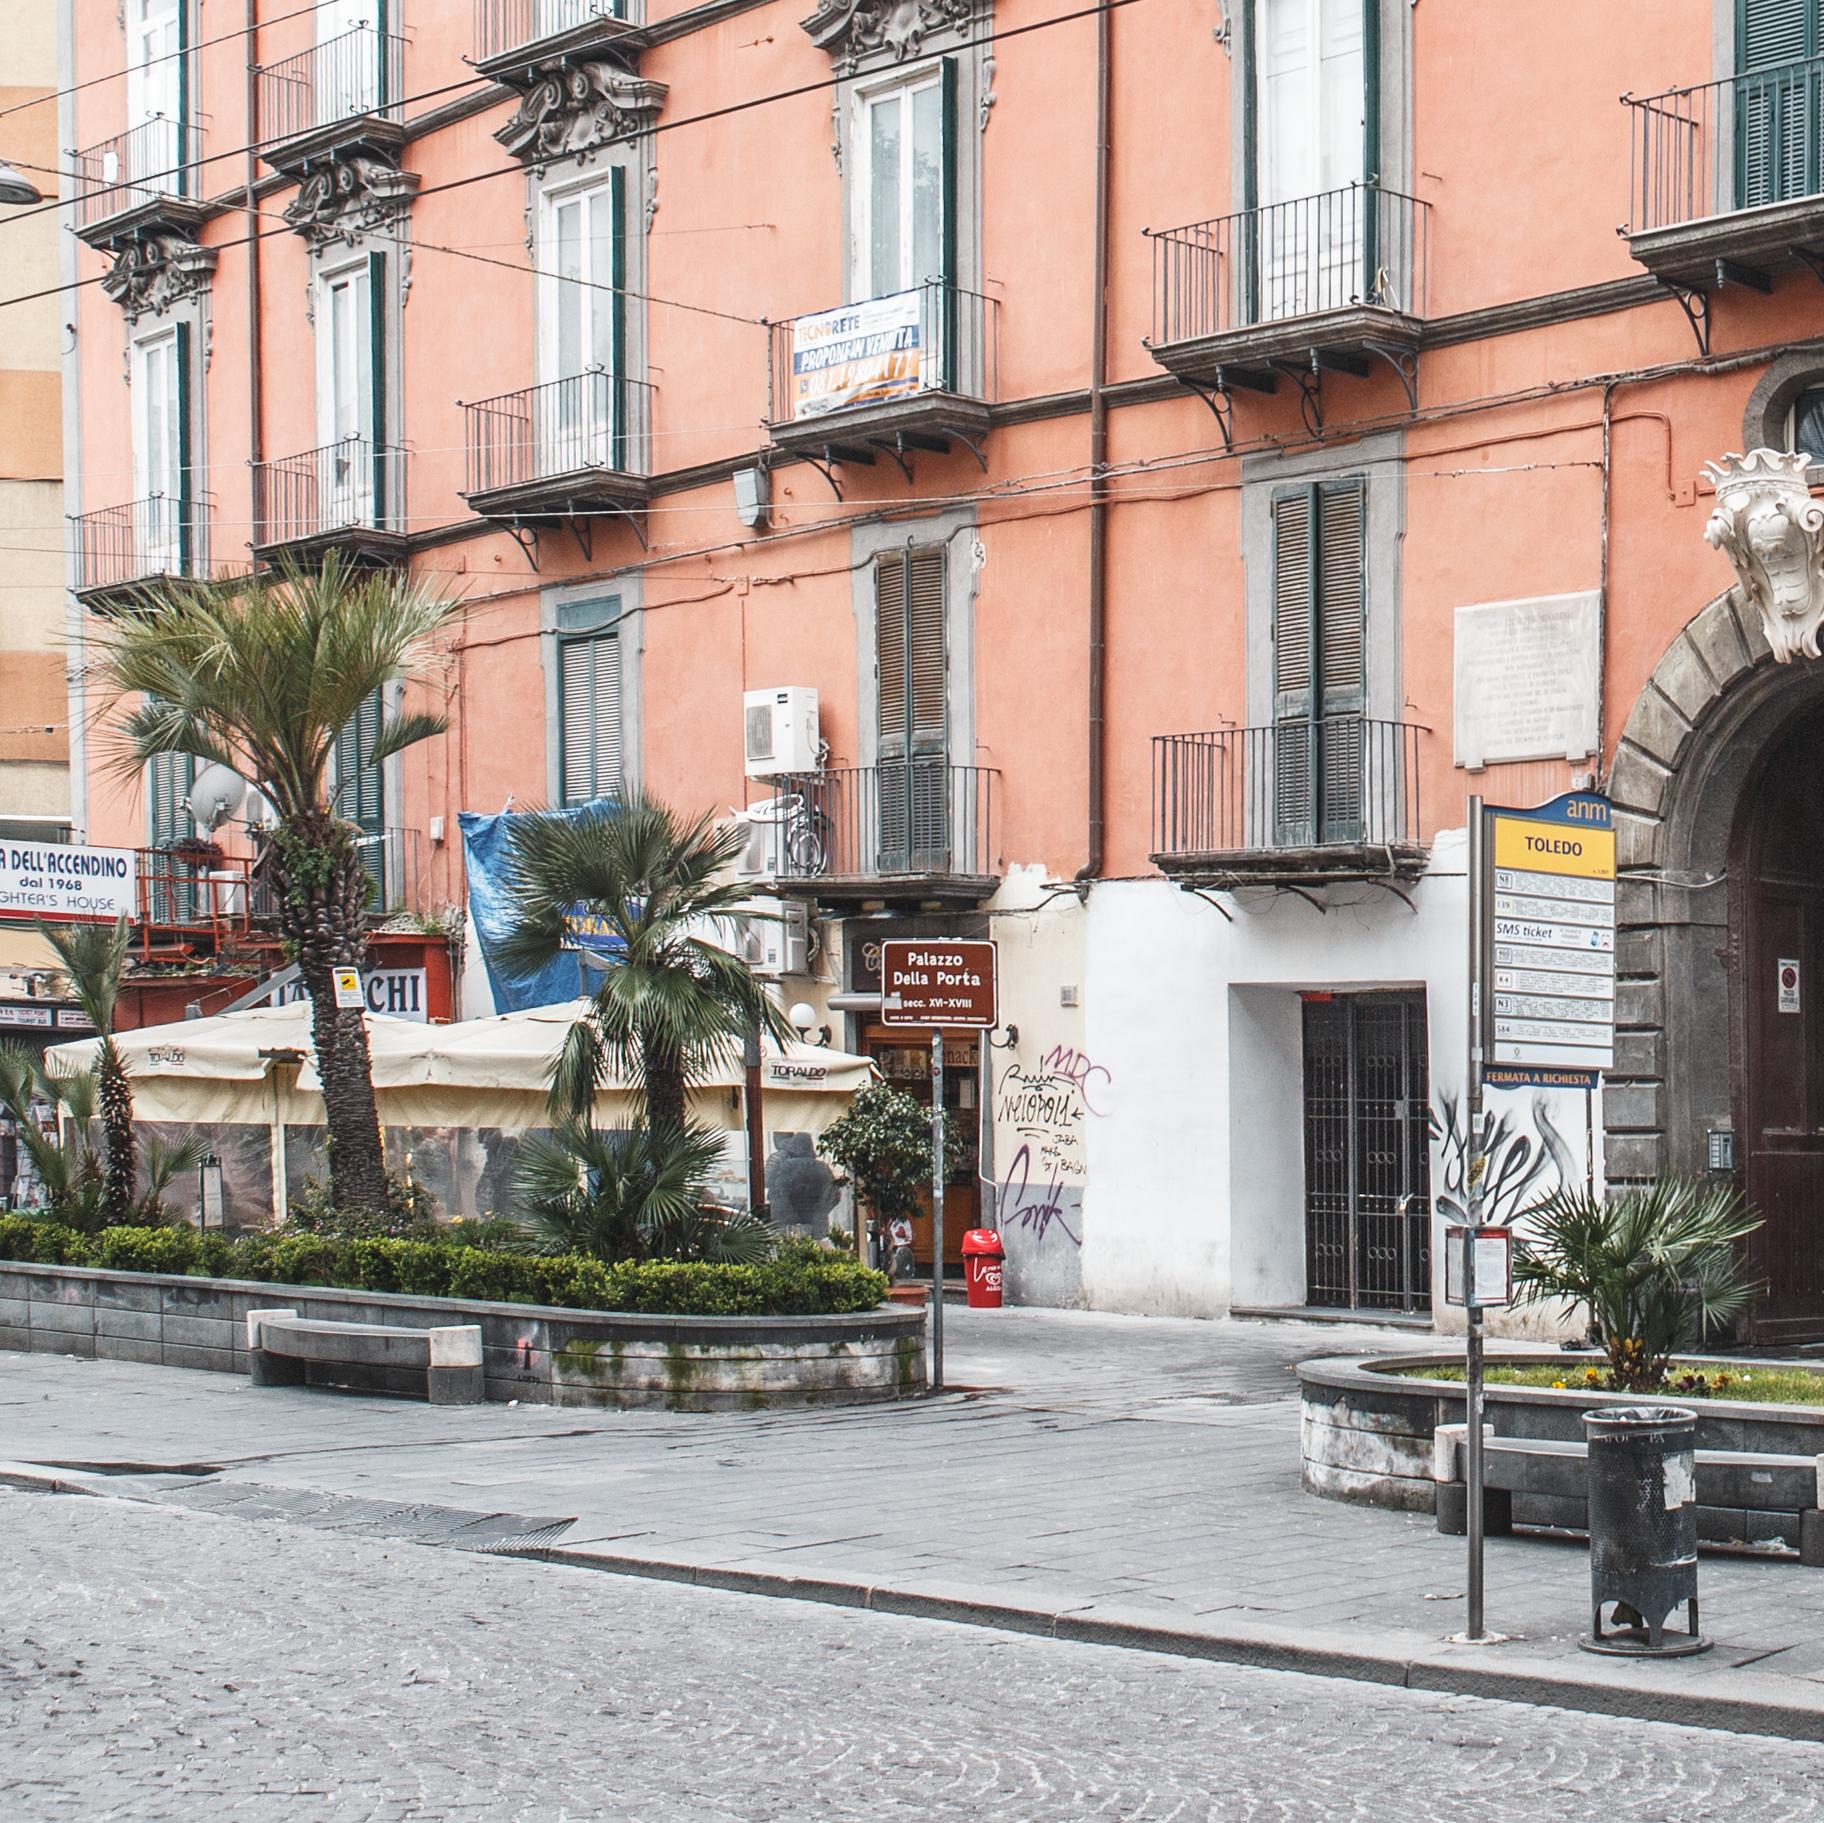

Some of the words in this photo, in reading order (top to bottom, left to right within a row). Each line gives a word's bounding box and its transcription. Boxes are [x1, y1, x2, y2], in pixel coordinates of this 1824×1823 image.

[1567, 799, 1607, 821] anm
[1525, 836, 1583, 856] TOLEDO
[12, 849, 127, 878] DELL'ACCENDINO
[20, 877, 42, 888] dal
[49, 878, 82, 891] 1968
[67, 896, 115, 910] HOUSE
[1496, 922, 1520, 936] SMS
[1523, 926, 1552, 938] ticket
[908, 952, 963, 966] Palazzo
[893, 971, 928, 985] Della
[937, 971, 981, 986] Porta
[903, 1000, 926, 1008] secc.
[929, 998, 972, 1008] XVI-XVIII
[770, 1065, 826, 1076] TORALDO
[1487, 1071, 1530, 1083] FERMATA
[1533, 1073, 1540, 1082] A
[1543, 1073, 1591, 1084] RICHIESTA
